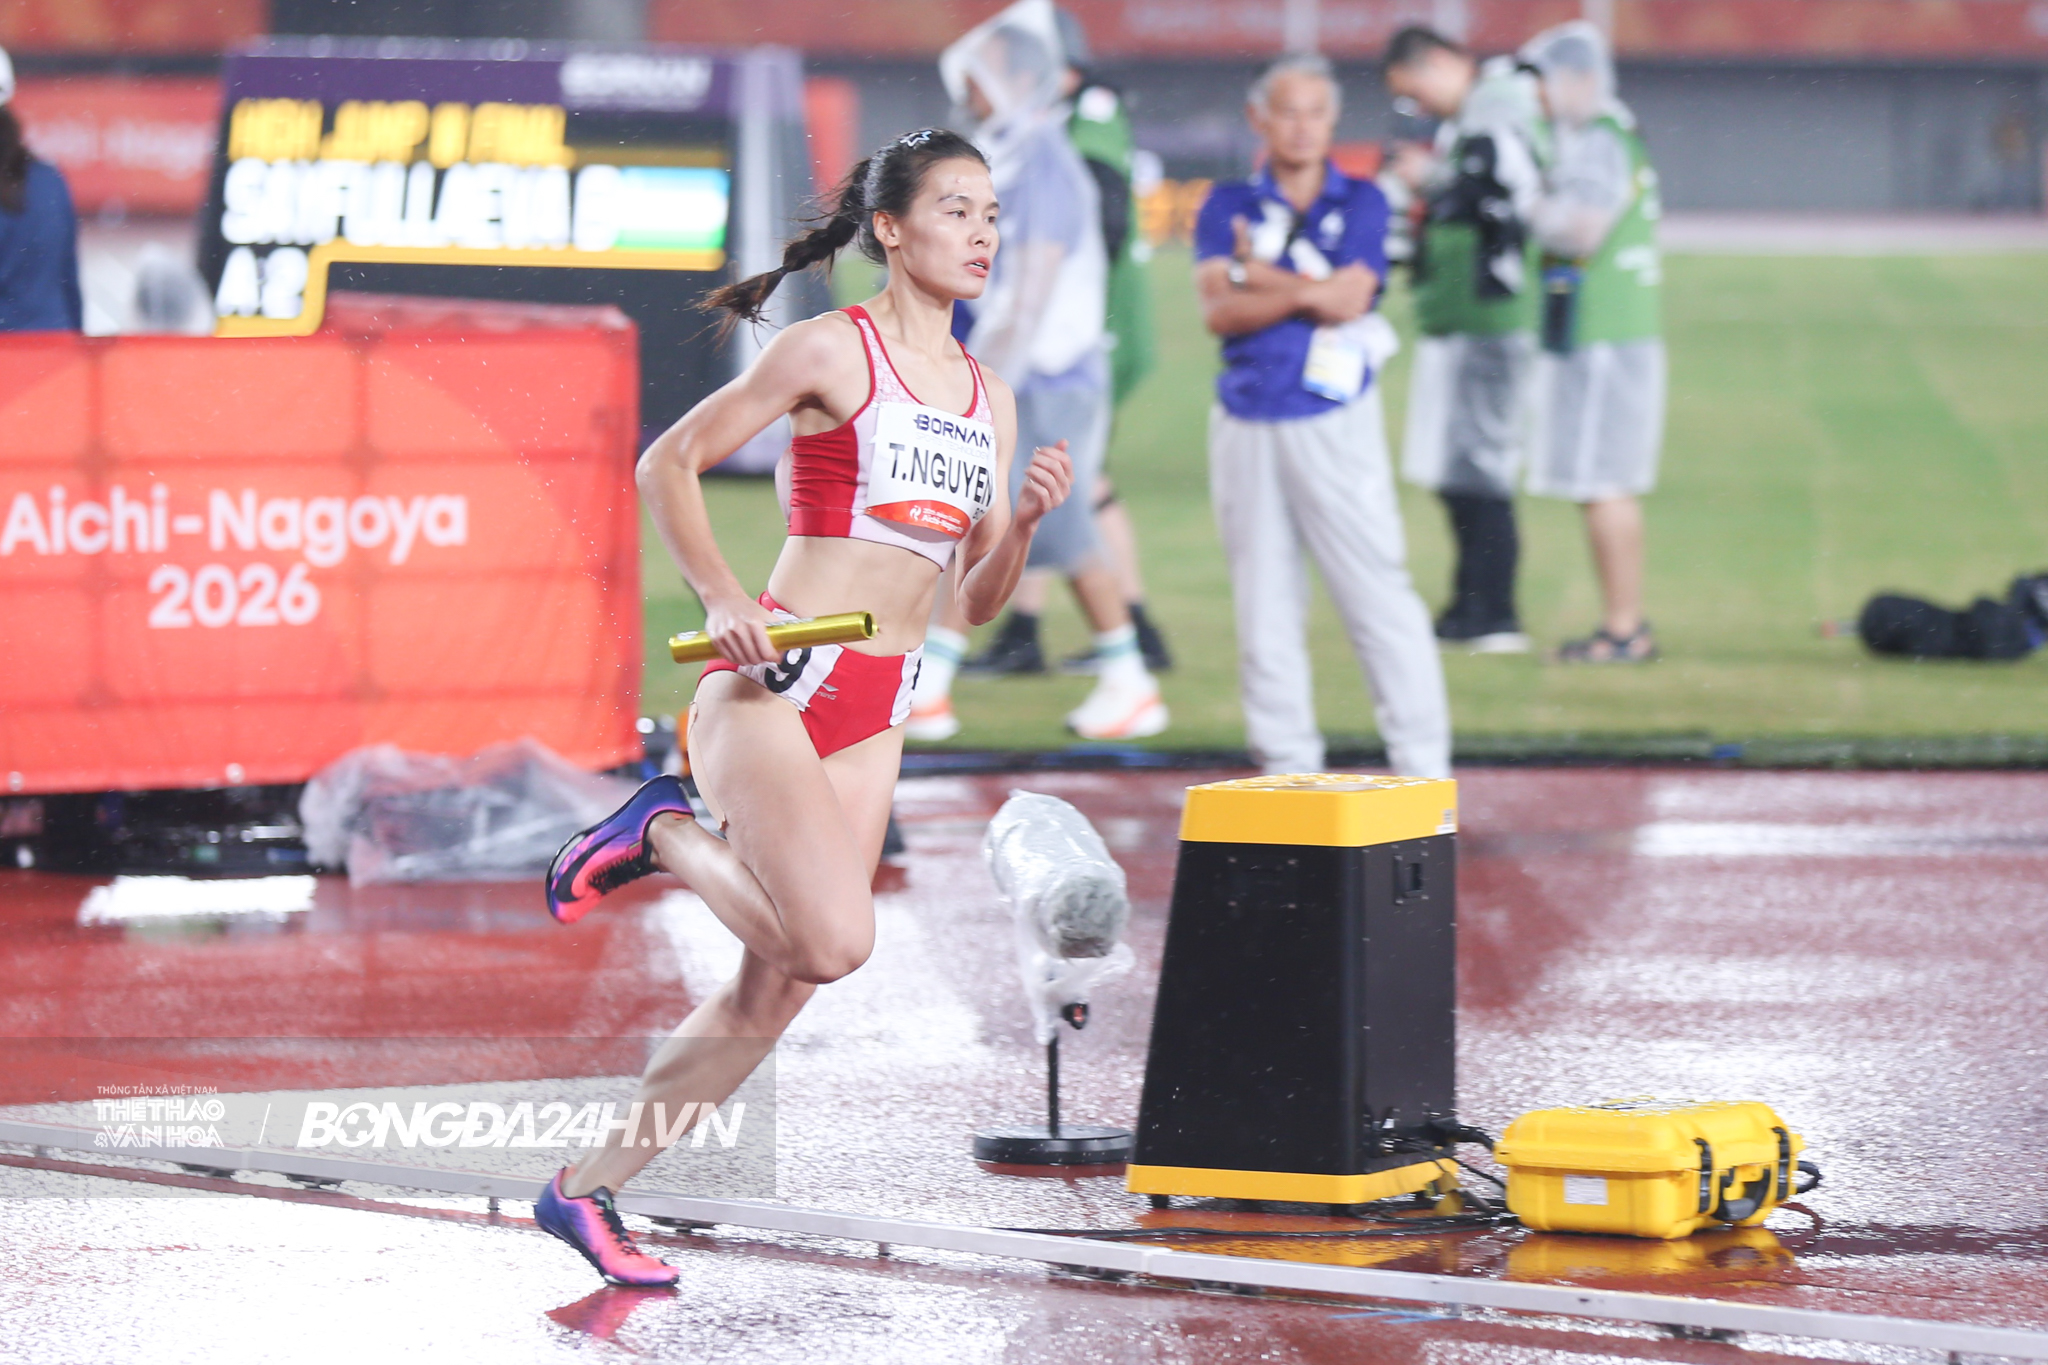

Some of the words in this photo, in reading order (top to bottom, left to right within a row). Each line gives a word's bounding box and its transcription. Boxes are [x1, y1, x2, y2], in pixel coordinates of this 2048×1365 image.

[913, 413, 991, 449] BORNAN
[889, 442, 993, 507] T.NGUYEN
[0, 483, 468, 567] Aichi-Nagoya
[148, 561, 321, 629] 2026
